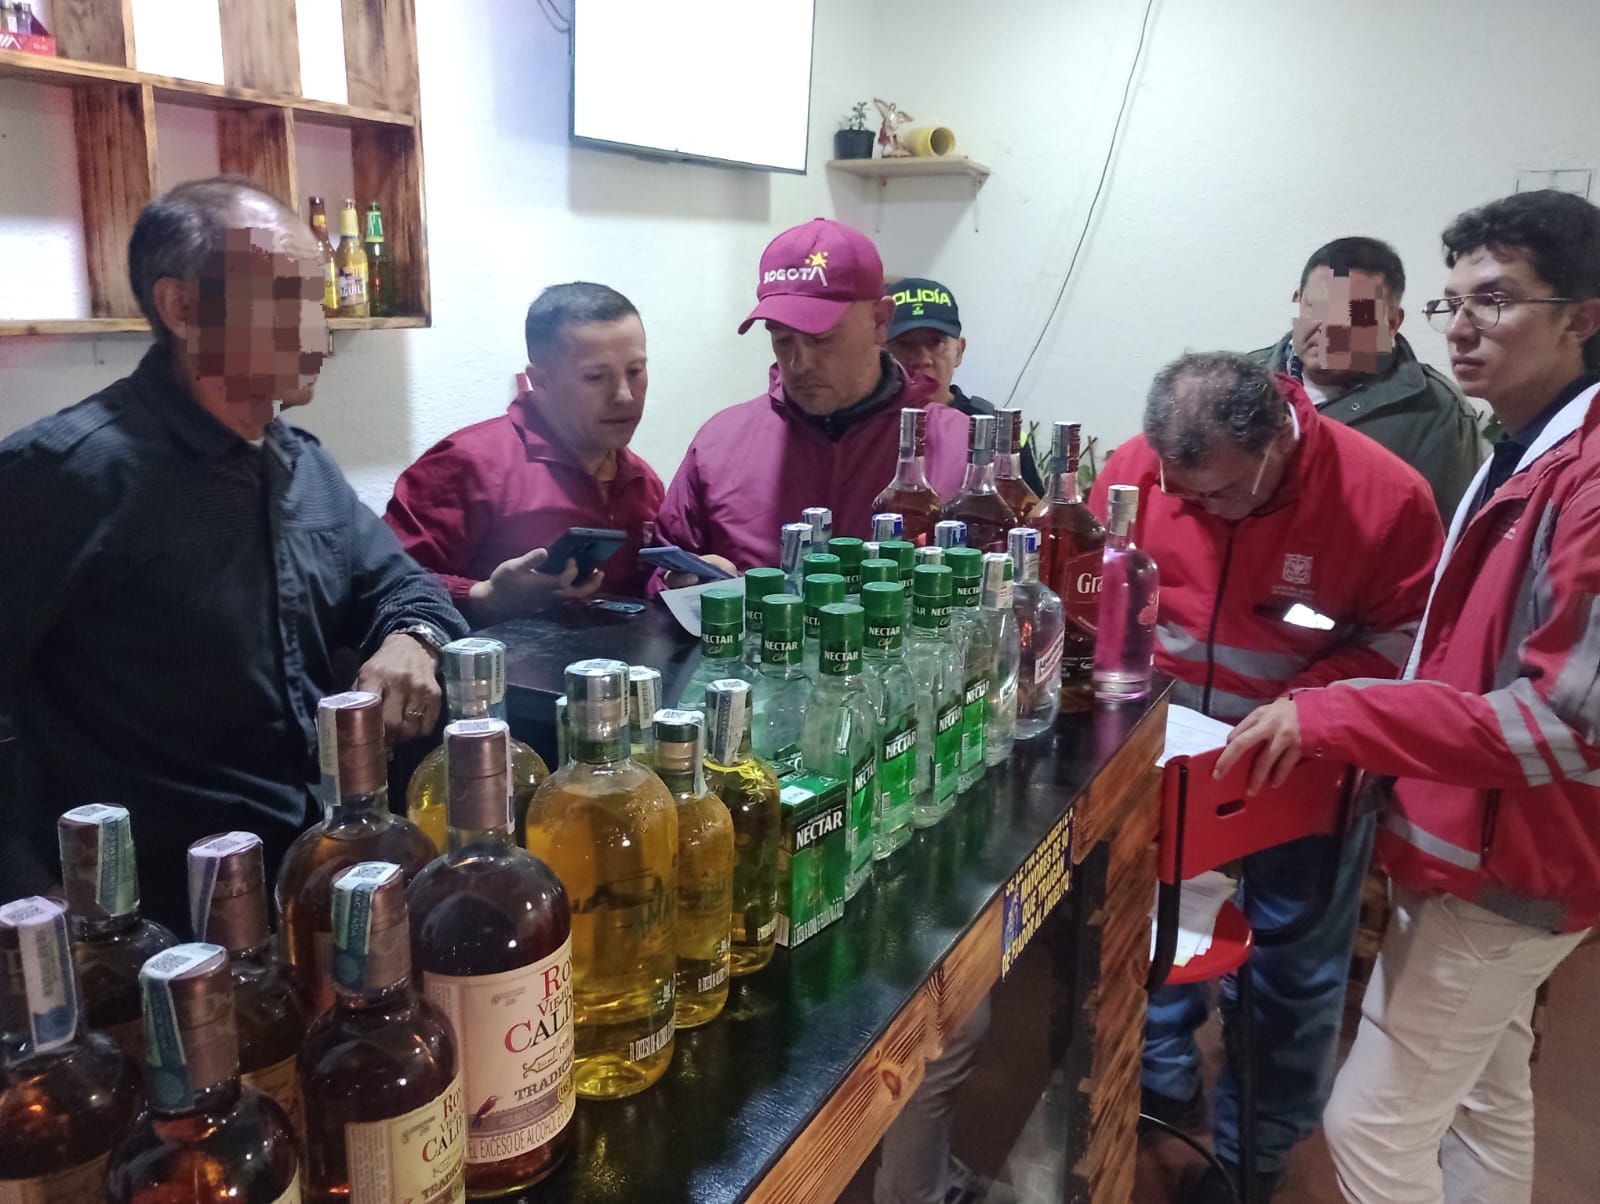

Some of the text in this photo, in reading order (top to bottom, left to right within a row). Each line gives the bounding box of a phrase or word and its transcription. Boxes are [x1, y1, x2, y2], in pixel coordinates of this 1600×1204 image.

[892, 288, 952, 307] OLICÍA
[701, 632, 734, 645] NECTAR
[869, 626, 901, 637] NECTAR
[764, 640, 799, 652] NECTAR
[824, 650, 860, 662] NECTAR
[885, 730, 917, 760] NECTAR
[796, 810, 843, 850] NECTAR
[480, 1136, 511, 1158] EXCESO
[514, 1132, 526, 1150] DE
